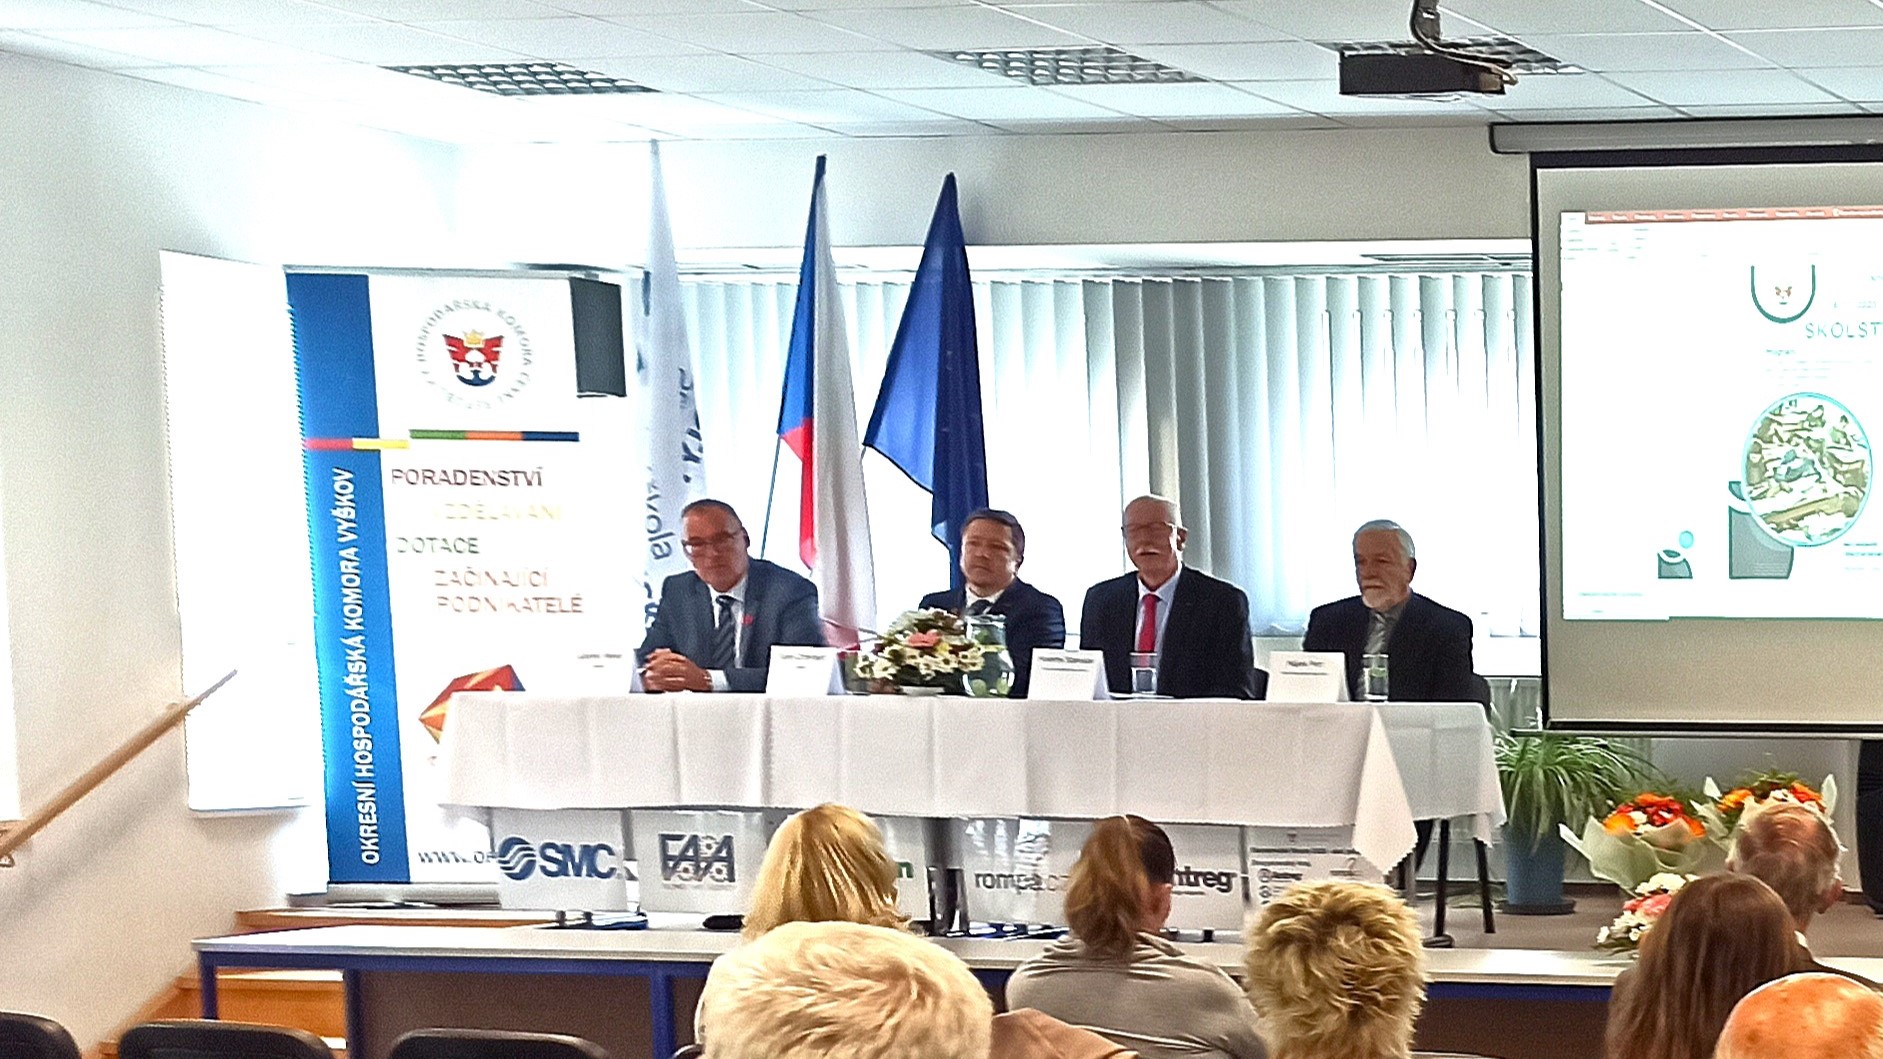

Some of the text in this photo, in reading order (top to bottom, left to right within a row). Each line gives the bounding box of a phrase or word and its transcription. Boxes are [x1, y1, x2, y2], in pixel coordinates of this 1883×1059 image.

[391, 466, 543, 487] PORADENSTVÍ
[396, 537, 480, 554] DOTACE
[330, 467, 380, 866] OKRESNÍ HOSPODÁŘSKÁ KOMORA VYŠKOV
[539, 841, 618, 879] SMC
